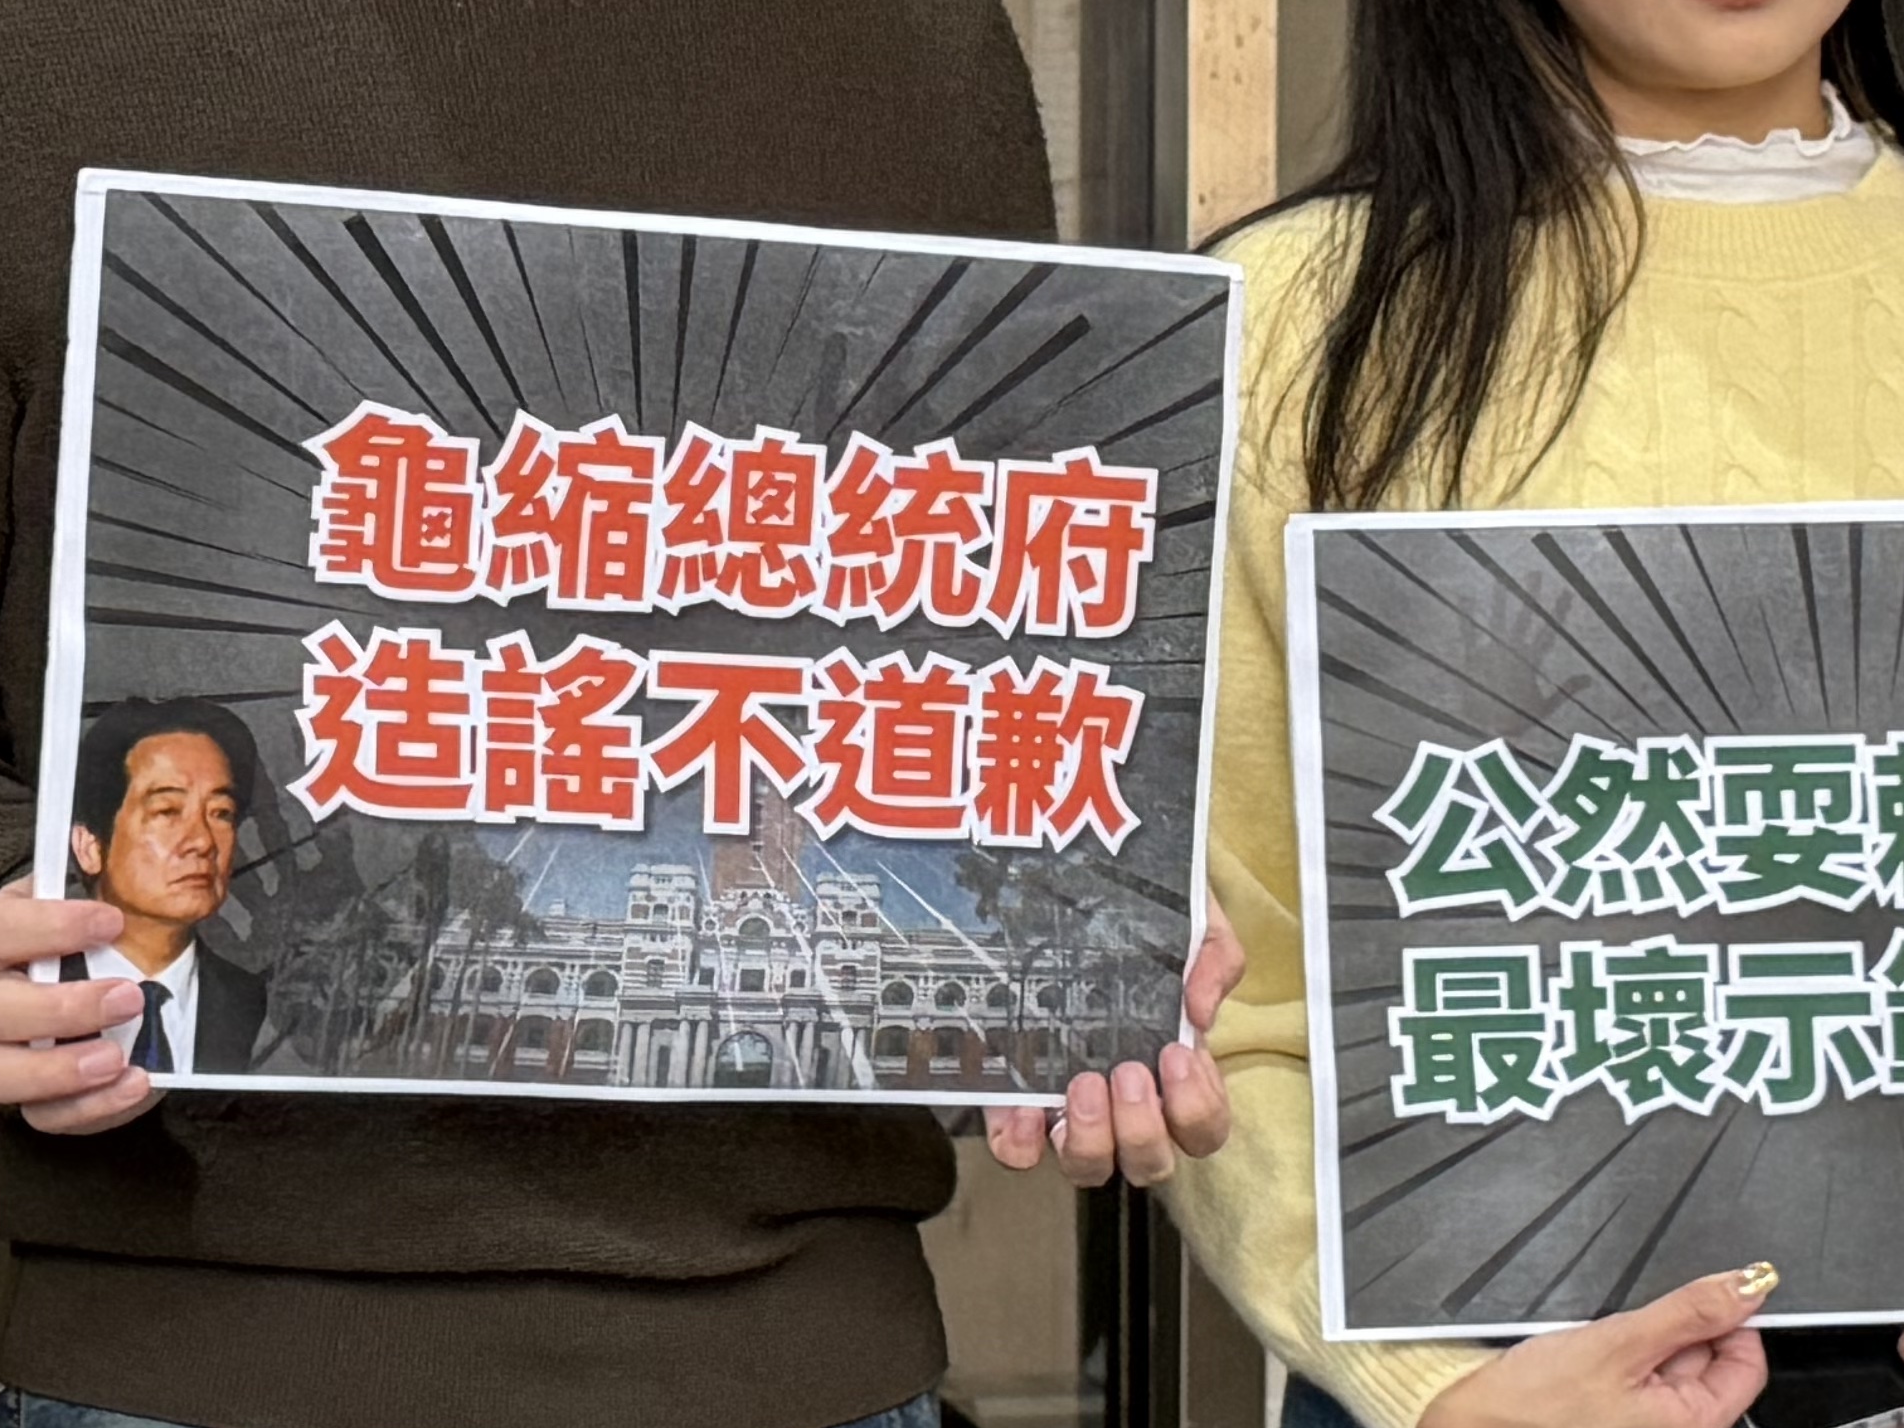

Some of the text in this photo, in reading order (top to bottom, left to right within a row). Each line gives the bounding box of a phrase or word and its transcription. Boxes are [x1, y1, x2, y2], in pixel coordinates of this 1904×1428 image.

[315, 410, 1154, 632] 龜縮總統府
[302, 633, 1138, 842] 造謠不道歉
